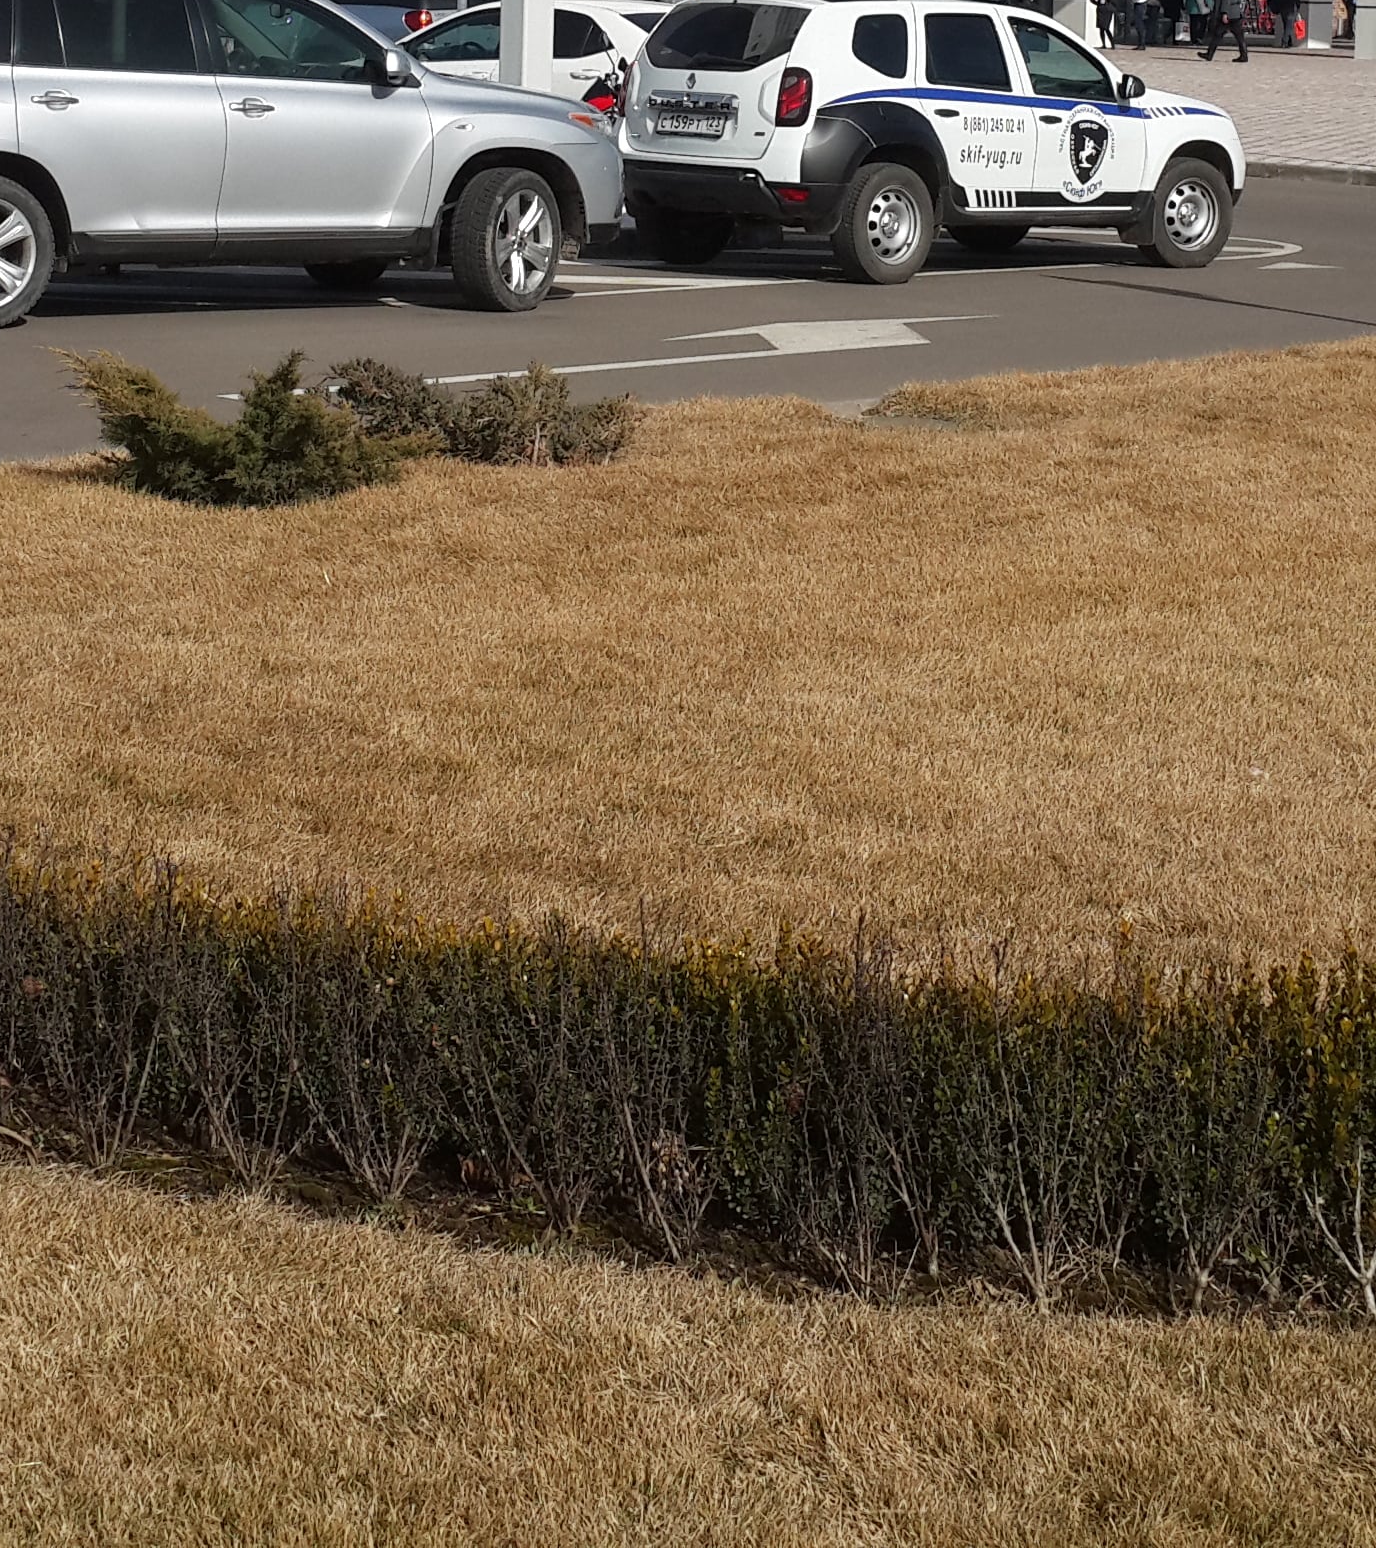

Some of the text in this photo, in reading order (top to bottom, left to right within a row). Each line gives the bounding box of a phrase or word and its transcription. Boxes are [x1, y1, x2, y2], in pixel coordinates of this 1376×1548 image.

[649, 96, 730, 110] DUSTER
[964, 116, 968, 131] 8
[990, 117, 1003, 133] 245
[1006, 118, 1014, 132] 02
[1016, 118, 1025, 133] 41
[960, 144, 1022, 169] skif-yug.ru
